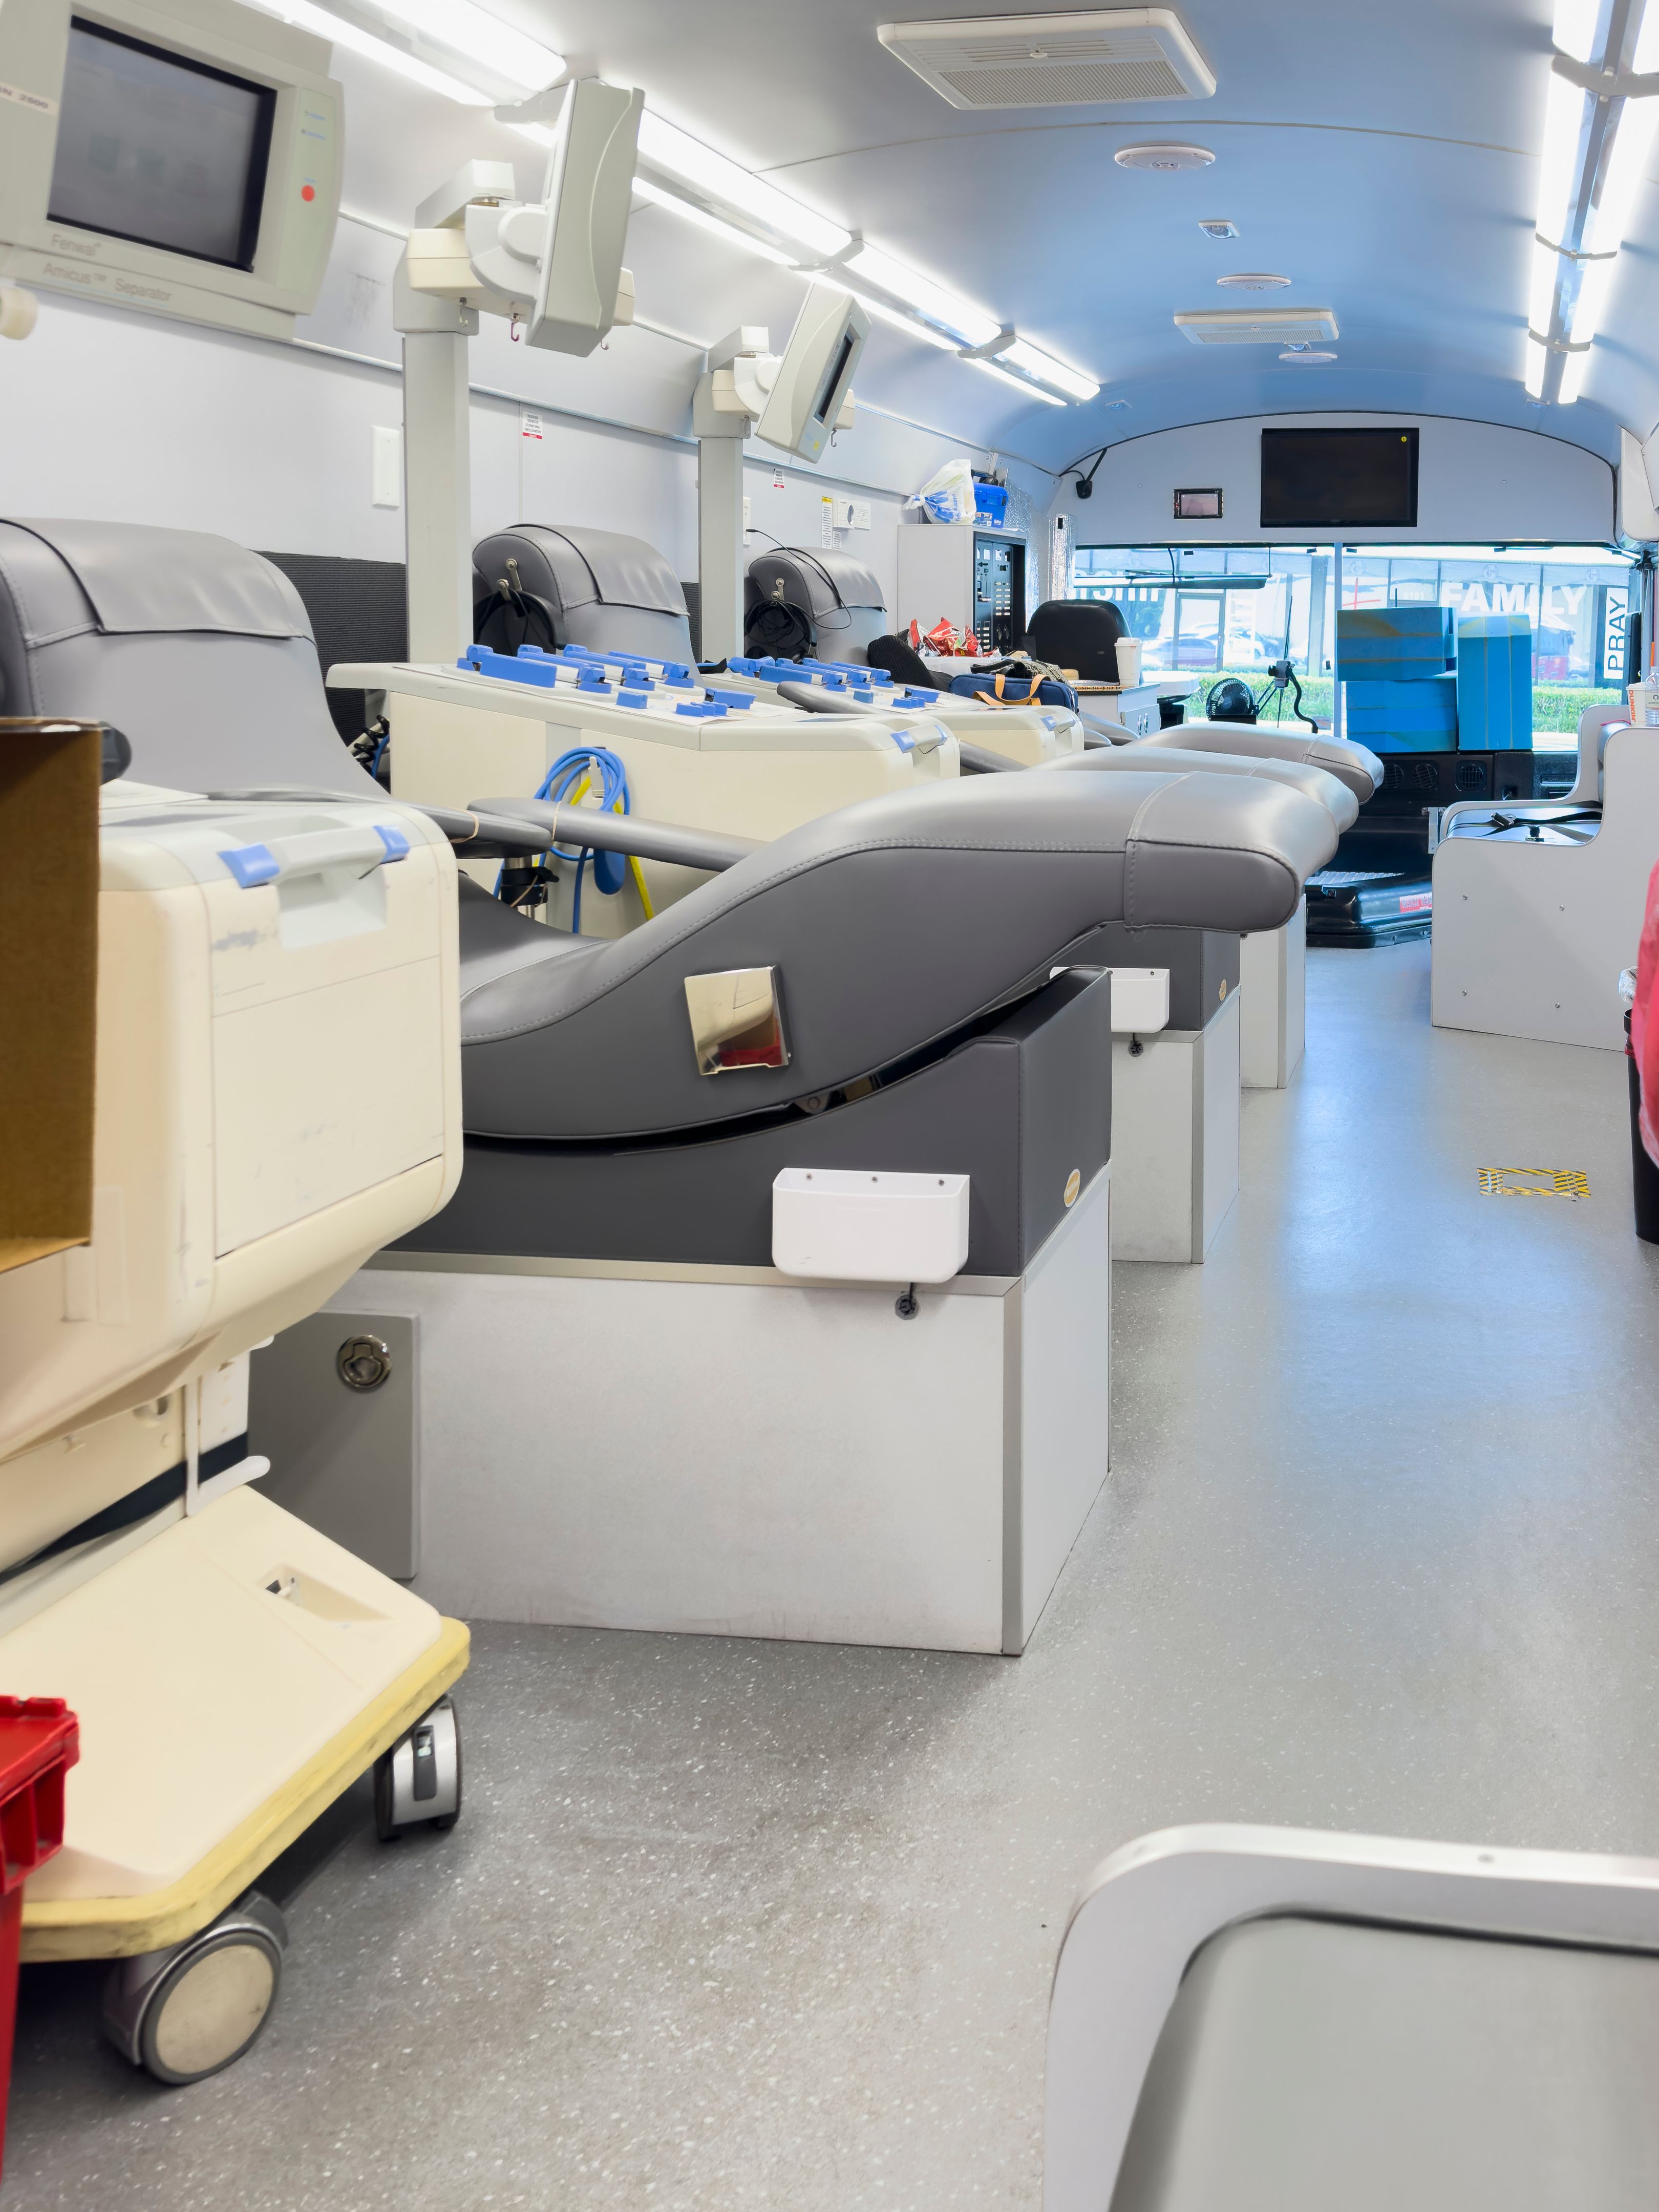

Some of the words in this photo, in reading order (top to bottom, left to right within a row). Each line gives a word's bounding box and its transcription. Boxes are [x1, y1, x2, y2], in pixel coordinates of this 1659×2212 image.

[19, 94, 49, 109] 2500
[115, 278, 172, 301] Separator
[1441, 582, 1587, 615] FAMILY
[1608, 596, 1625, 671] PRAY
[1402, 897, 1419, 908] WATCH
